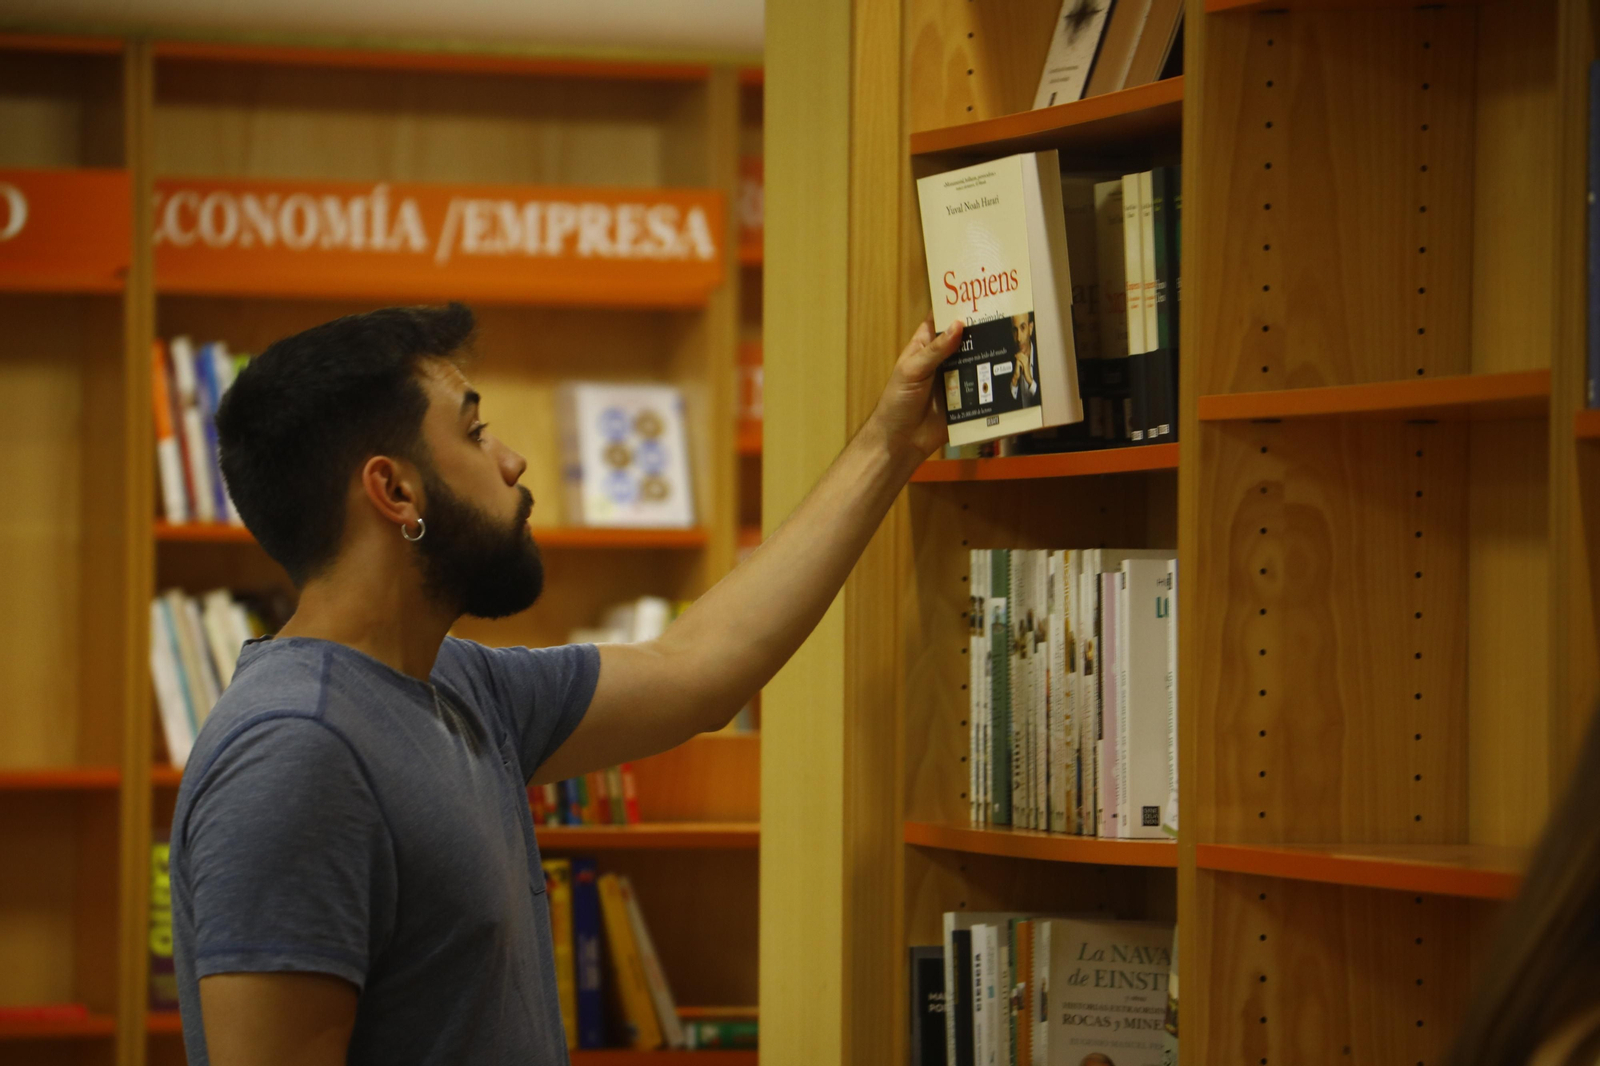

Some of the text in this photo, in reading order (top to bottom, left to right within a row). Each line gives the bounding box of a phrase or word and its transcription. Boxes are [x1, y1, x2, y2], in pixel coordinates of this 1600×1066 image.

[946, 194, 1000, 216] Yuval Noah Harari
[150, 183, 426, 253] CONOMÍA
[943, 266, 1019, 313] Sapiens
[1077, 942, 1106, 962] La
[1067, 967, 1090, 987] de
[1062, 1013, 1166, 1032] ROCAS y MINE
